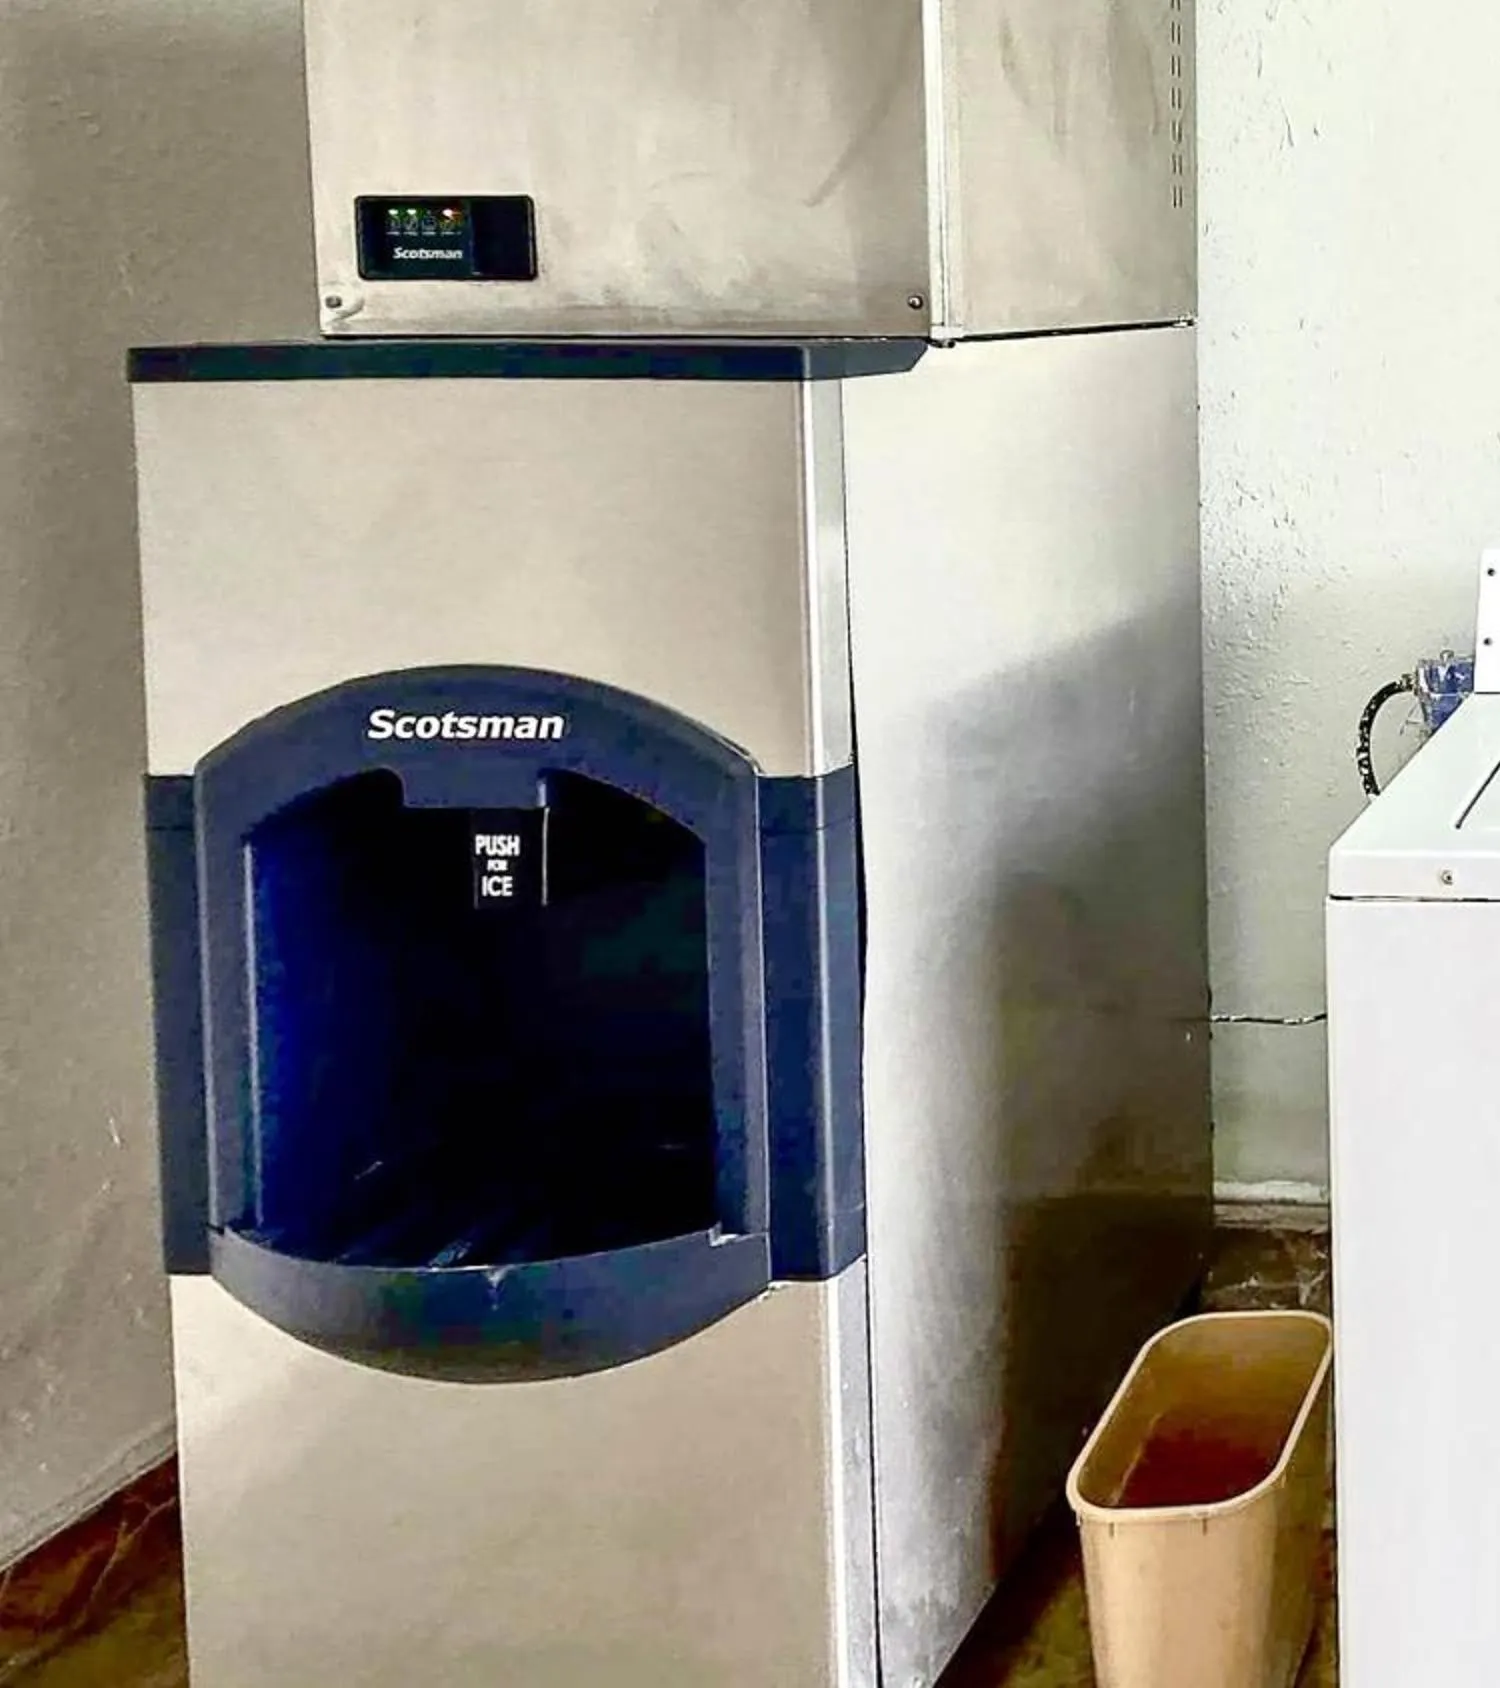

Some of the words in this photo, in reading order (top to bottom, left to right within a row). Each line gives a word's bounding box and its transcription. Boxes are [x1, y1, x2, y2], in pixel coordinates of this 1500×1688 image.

[392, 246, 463, 259] Scotsman
[367, 709, 565, 739] Scotsman
[475, 835, 520, 856] PUSH
[487, 859, 508, 871] FOR
[481, 876, 513, 897] ICE
